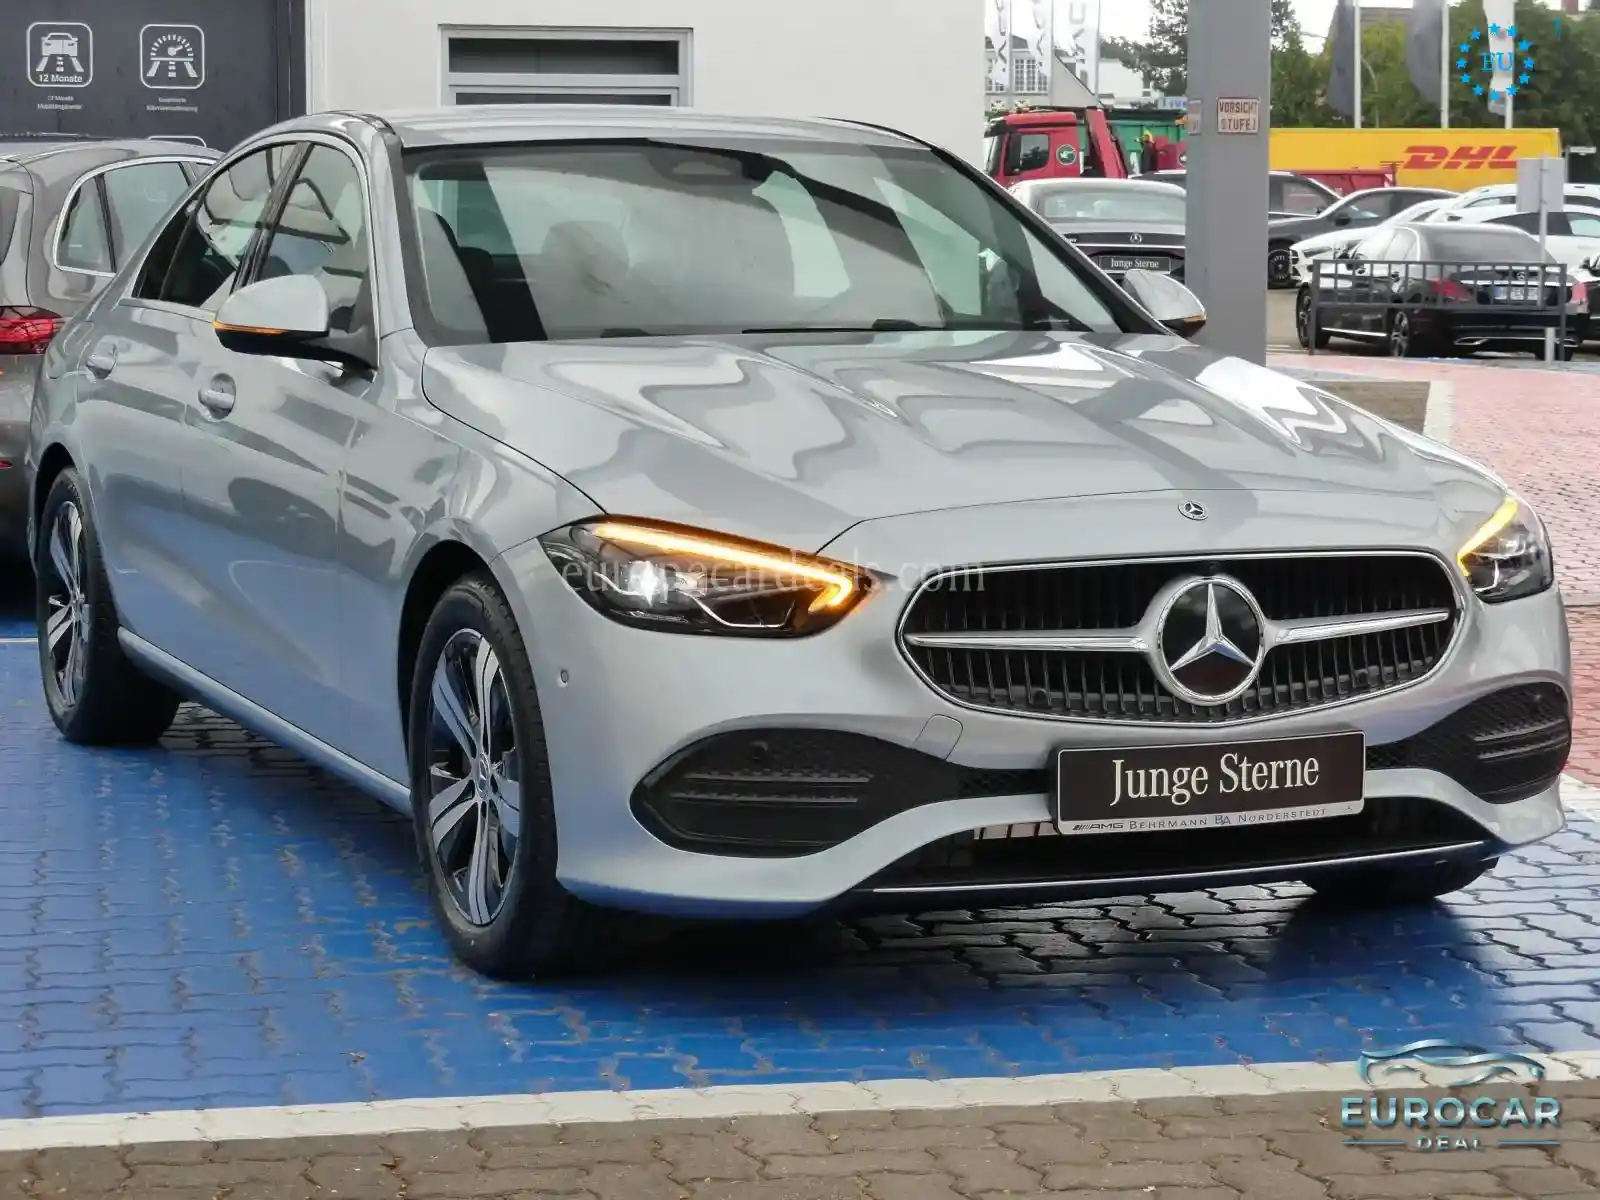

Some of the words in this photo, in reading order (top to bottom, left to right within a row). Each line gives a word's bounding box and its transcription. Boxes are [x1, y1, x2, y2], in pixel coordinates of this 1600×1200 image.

[38, 74, 49, 82] 12
[51, 74, 83, 83] Monate
[1219, 101, 1258, 114] VORSICHT
[1402, 145, 1518, 170] DHL
[1110, 258, 1133, 269] Junge
[1135, 258, 1160, 269] Sterne
[1109, 759, 1208, 806] Junge
[1219, 752, 1320, 794] Sterne
